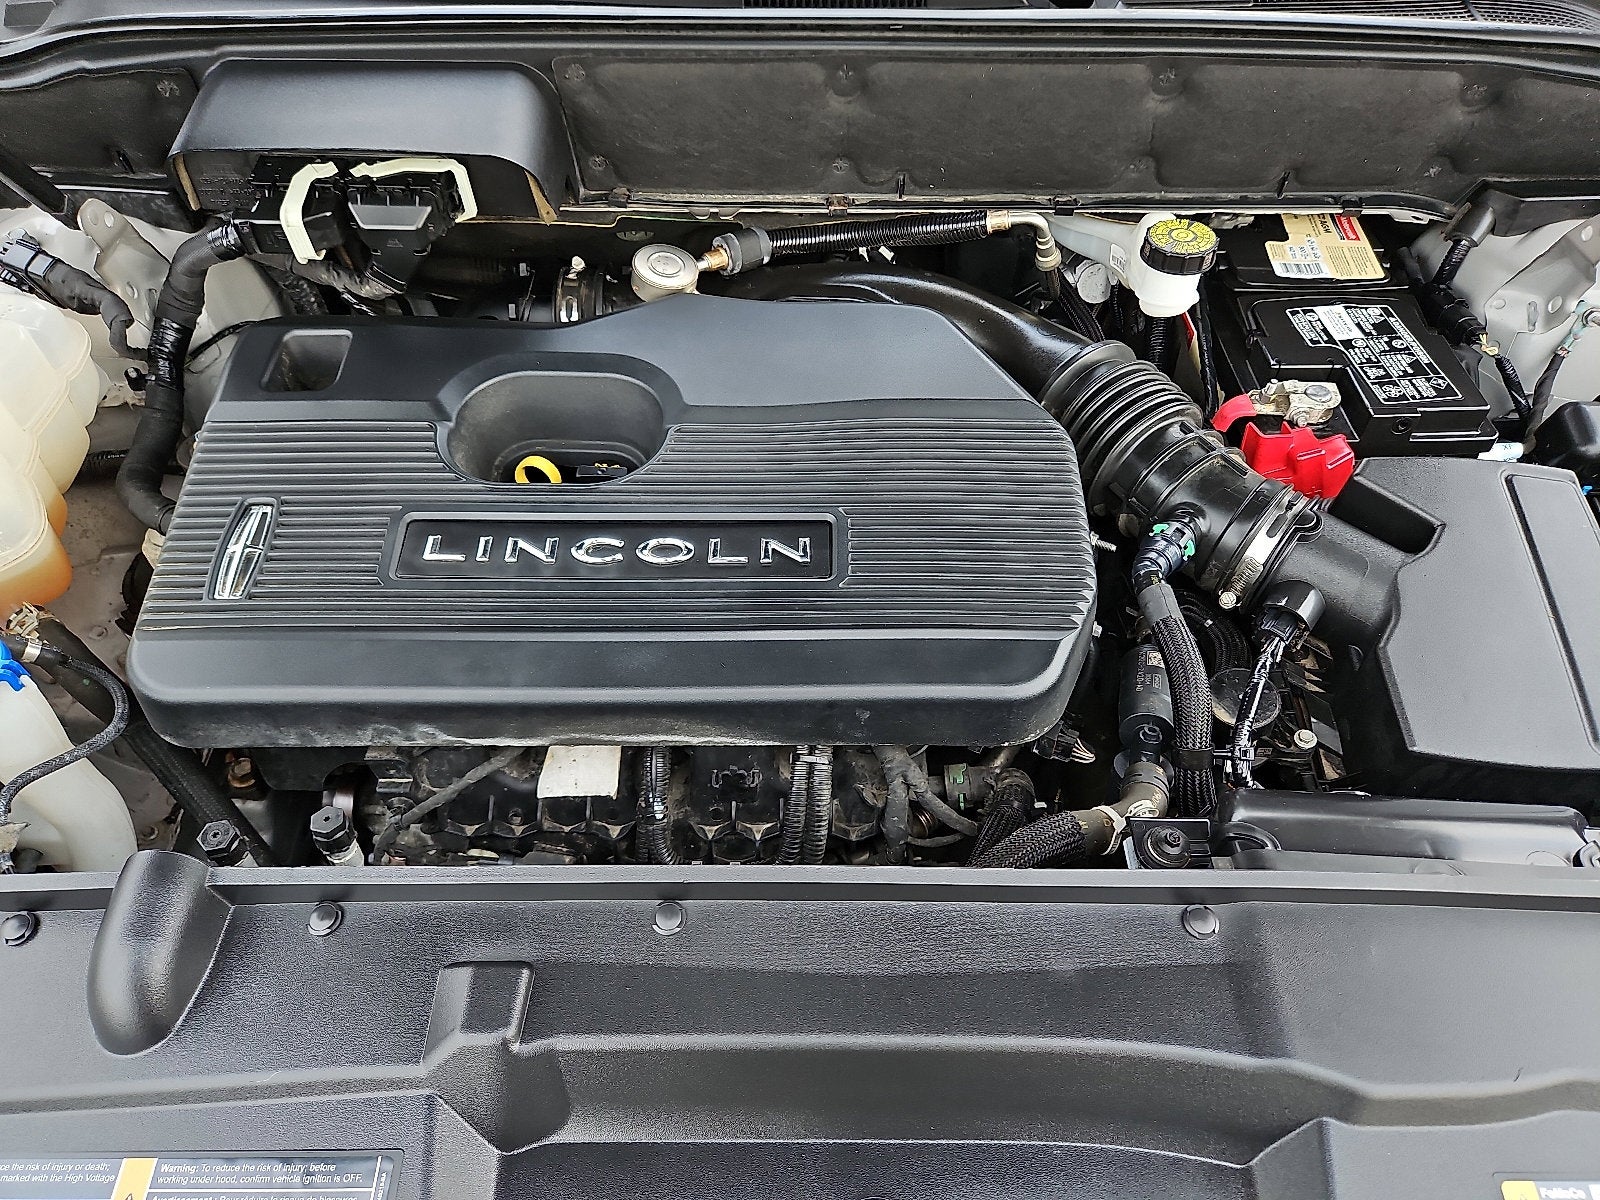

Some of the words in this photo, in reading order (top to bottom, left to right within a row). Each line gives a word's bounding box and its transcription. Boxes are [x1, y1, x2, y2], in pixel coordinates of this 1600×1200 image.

[421, 534, 812, 565] LINCOLN
[11, 1162, 24, 1171] the
[25, 1162, 41, 1171] risk
[42, 1162, 52, 1171] of
[51, 1162, 73, 1173] injury
[160, 1163, 199, 1174] Warning:
[201, 1163, 211, 1172] To
[212, 1163, 240, 1172] reduce
[241, 1163, 255, 1172] the
[256, 1163, 272, 1172] risk
[273, 1162, 283, 1172] of
[309, 1162, 336, 1172] before
[0, 1173, 31, 1182] marked
[31, 1173, 48, 1182] with
[49, 1173, 62, 1182] the
[64, 1173, 83, 1184] High
[86, 1173, 115, 1184] Voltage
[156, 1174, 189, 1185] working
[190, 1174, 213, 1184] under
[239, 1174, 270, 1183] confirm
[272, 1173, 301, 1183] vehicle
[302, 1173, 332, 1185] ignition
[333, 1173, 341, 1183] is
[343, 1173, 363, 1183] OFF.
